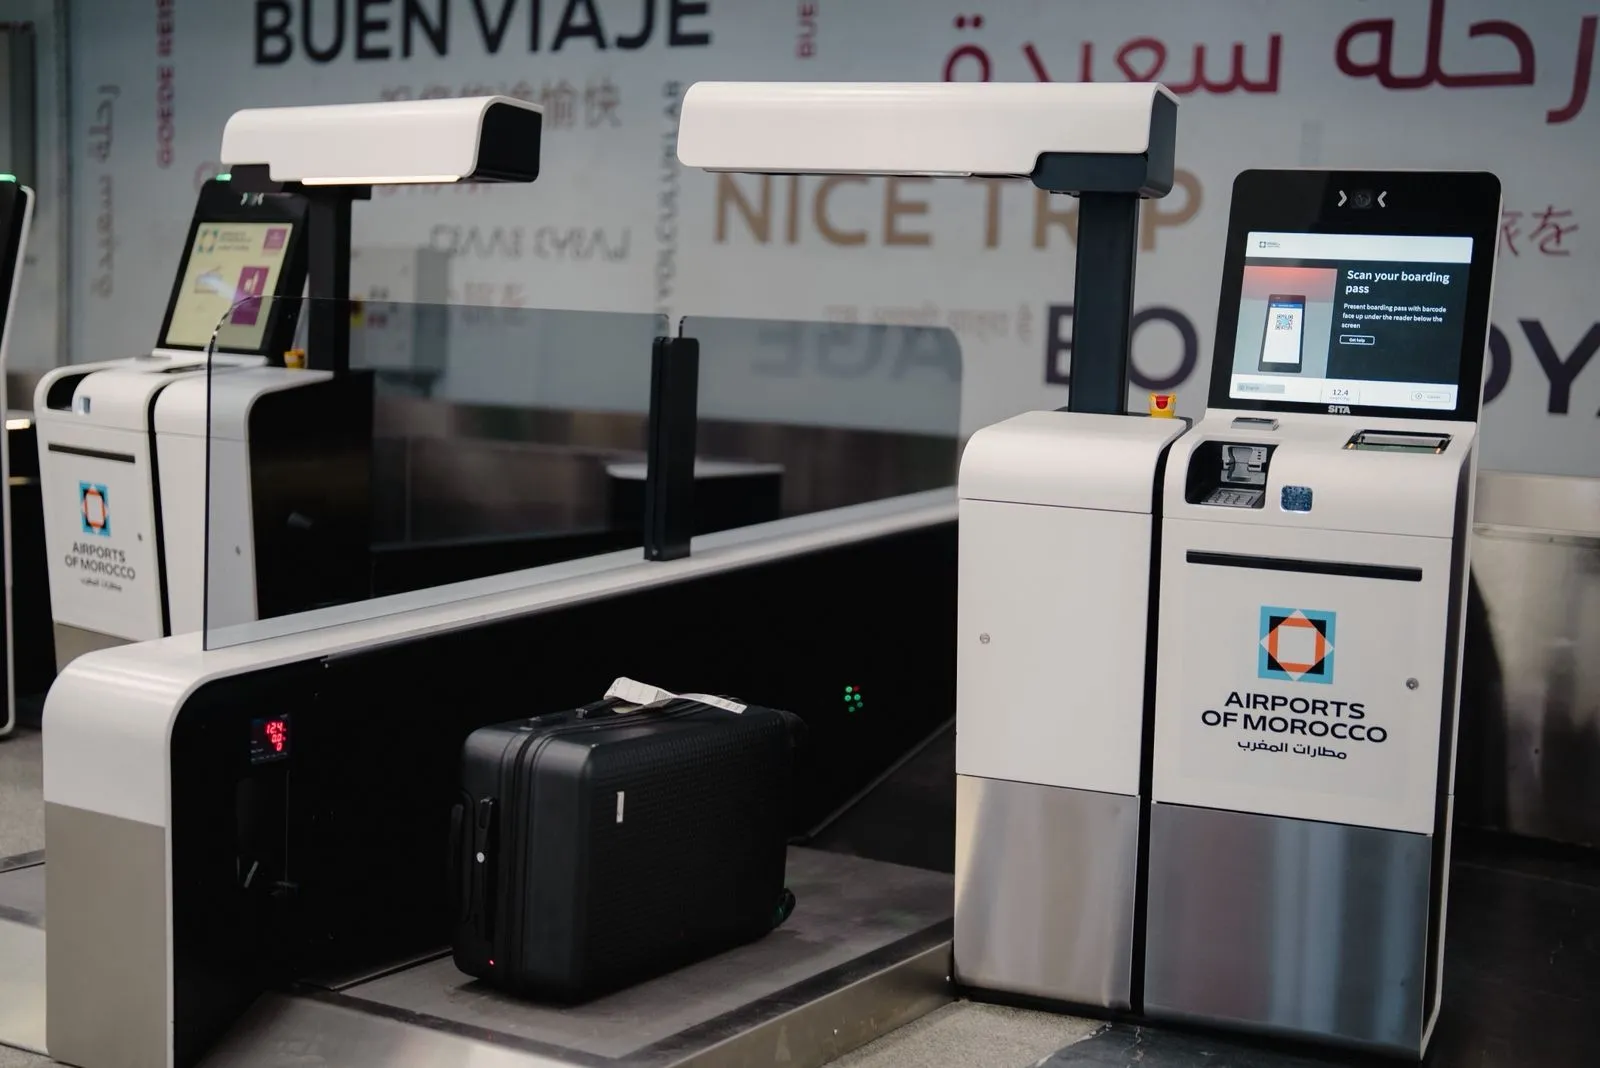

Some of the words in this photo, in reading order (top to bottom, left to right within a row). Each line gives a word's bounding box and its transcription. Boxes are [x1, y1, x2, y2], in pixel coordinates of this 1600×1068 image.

[714, 171, 934, 247] NICE
[965, 167, 1204, 251] TRP
[1347, 270, 1372, 280] Scan
[1374, 272, 1399, 283] your
[1401, 271, 1450, 285] boarding
[1345, 285, 1370, 295] pass
[1366, 303, 1392, 312] boarding
[1328, 404, 1351, 415] SITA
[72, 541, 126, 563] AIRPORTS
[64, 554, 79, 569] OF
[80, 558, 136, 581] MOROCCO
[1224, 691, 1366, 720] AIRPORTS
[1201, 710, 1238, 728] OF
[1242, 713, 1388, 743] MOROCCO
[1237, 739, 1288, 753] المغرب
[1293, 743, 1347, 760] مطارات
